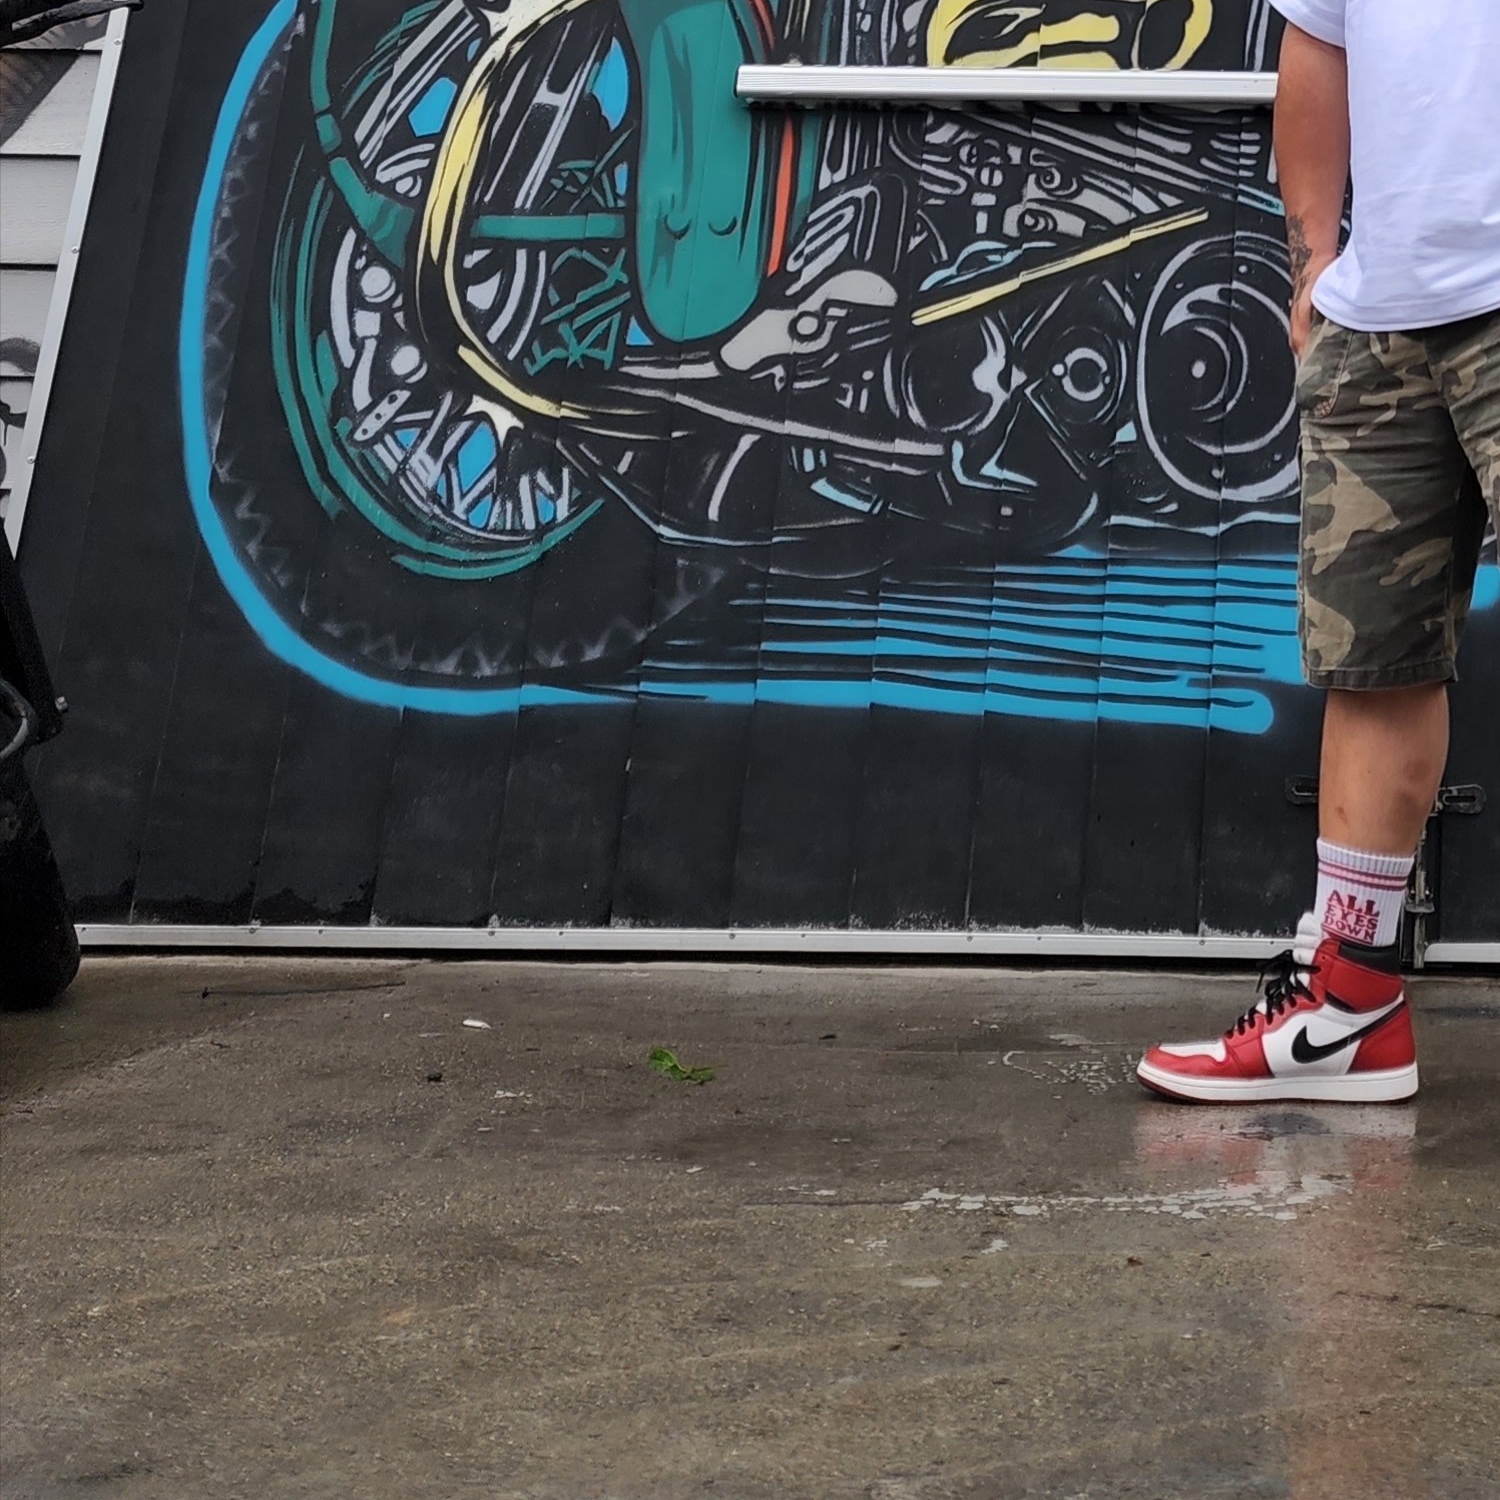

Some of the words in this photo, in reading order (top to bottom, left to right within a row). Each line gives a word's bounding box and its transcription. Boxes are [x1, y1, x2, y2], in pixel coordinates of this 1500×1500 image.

[1327, 889, 1381, 918] ALL
[1324, 916, 1376, 941] DOWN
[1325, 904, 1379, 931] EYES
